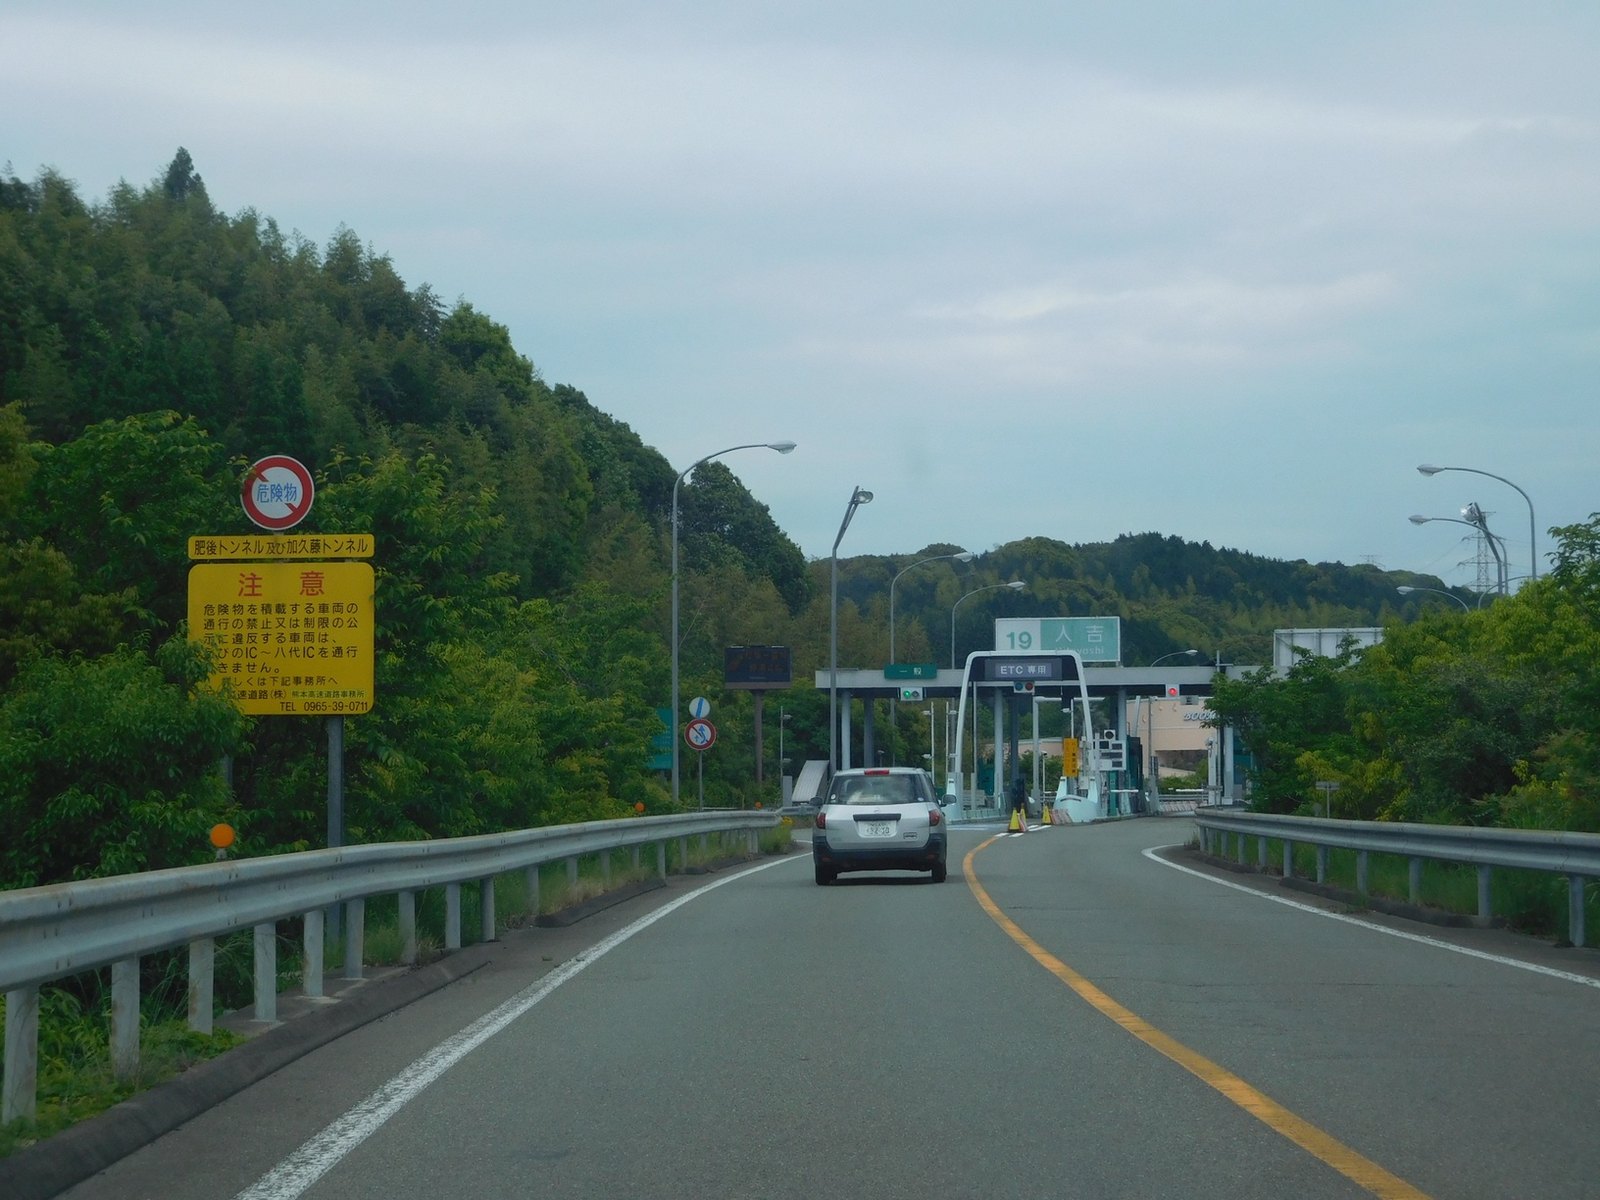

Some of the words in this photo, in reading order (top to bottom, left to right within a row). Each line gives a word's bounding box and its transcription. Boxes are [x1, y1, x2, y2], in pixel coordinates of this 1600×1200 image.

[257, 483, 297, 503] 危険物
[238, 570, 325, 597] 注意
[203, 602, 359, 616] 危険物を積載する車両の
[203, 617, 359, 630] 通行の禁止又は制限の公
[1006, 631, 1033, 650] 19
[1055, 625, 1105, 643] 人吉
[217, 662, 281, 674] きません。
[1000, 666, 1023, 675] ETC
[280, 702, 297, 712] TEL
[303, 701, 368, 712] 0965-39-0711
